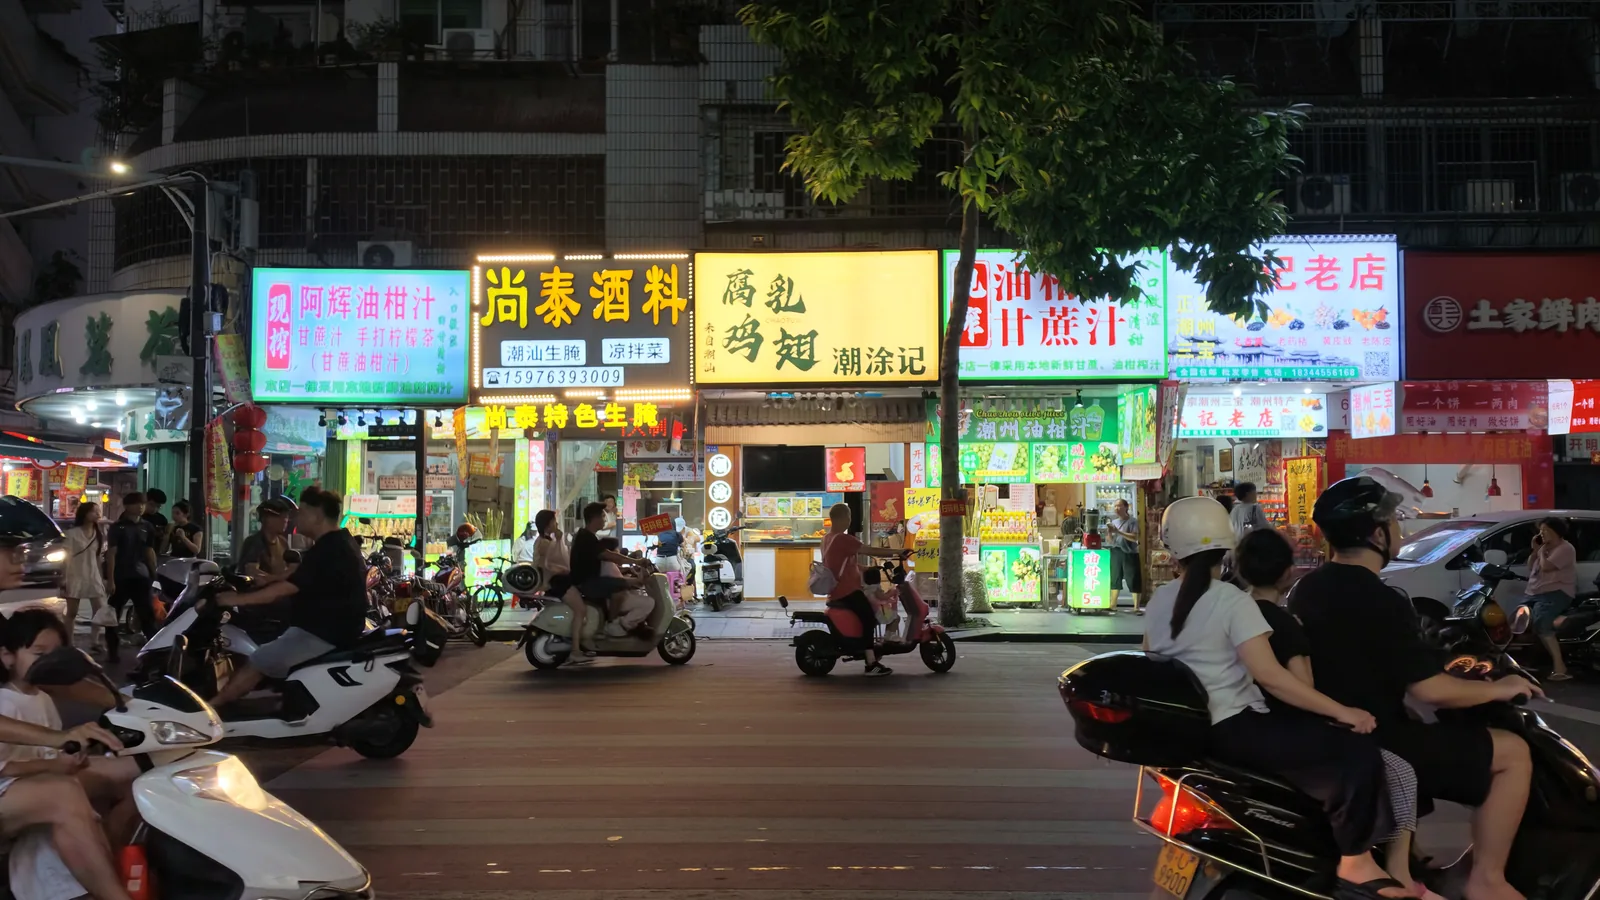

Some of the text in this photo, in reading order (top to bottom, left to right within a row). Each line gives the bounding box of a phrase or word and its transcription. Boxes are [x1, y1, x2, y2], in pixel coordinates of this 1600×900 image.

[300, 285, 436, 320] 阿辉油柑汁
[480, 264, 687, 328] 尚泰酒料
[722, 268, 806, 314] 腐乳
[268, 293, 290, 360] 现榨
[994, 306, 1125, 346] 甘蔗汁
[1176, 318, 1216, 337] 潮州
[1467, 297, 1600, 332] 土家鲜肉
[298, 327, 434, 347] 甘蔗汁 手打柠檬茶
[507, 342, 663, 362] 潮汕生腌 凉拌菜
[722, 313, 820, 371] 鸡翅
[1177, 340, 1216, 359] 三宝
[504, 369, 621, 384] 15976393009
[833, 346, 926, 376] 潮涂记
[483, 403, 658, 430] 尚泰特色生腌
[1417, 397, 1518, 409] 一个饼 一两肉
[977, 418, 1090, 440] 潮州油柑汁
[913, 449, 922, 484] 开元店
[1084, 552, 1100, 590] 油柑汁
